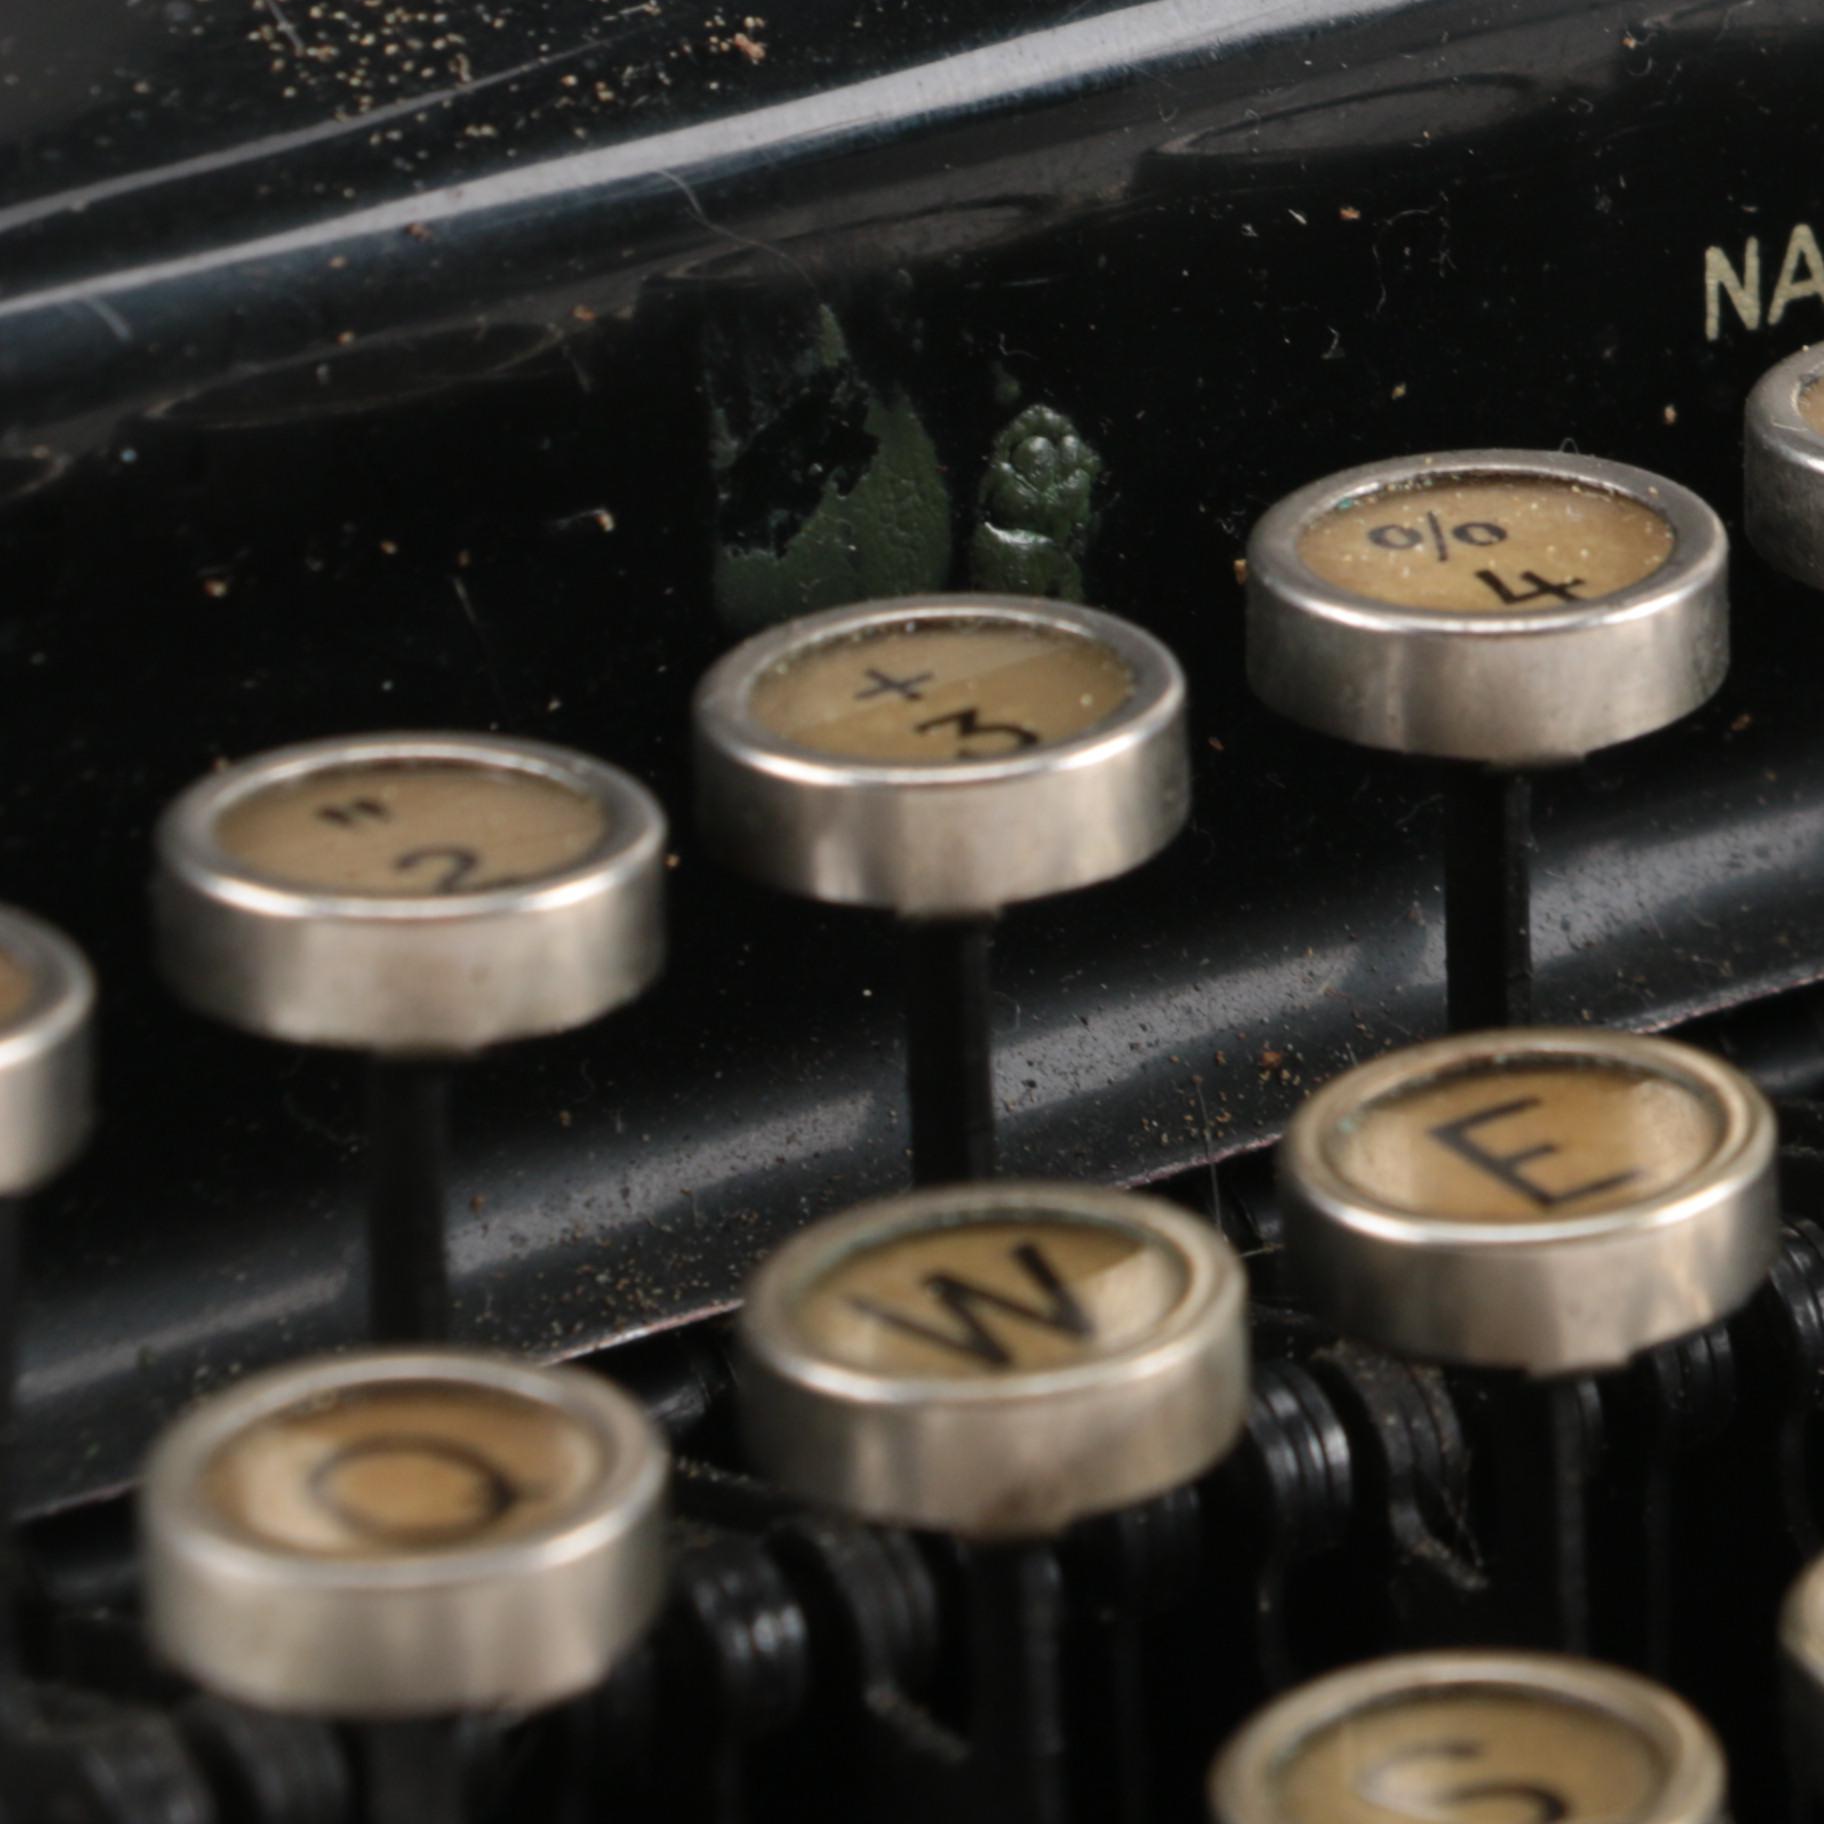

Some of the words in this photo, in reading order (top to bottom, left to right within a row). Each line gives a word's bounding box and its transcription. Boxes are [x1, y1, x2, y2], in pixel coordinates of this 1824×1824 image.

[1473, 569, 1588, 606] 4
[916, 706, 1042, 763] 3
[395, 845, 520, 894] 2
[1430, 1095, 1644, 1212] E
[845, 1240, 1094, 1369] W
